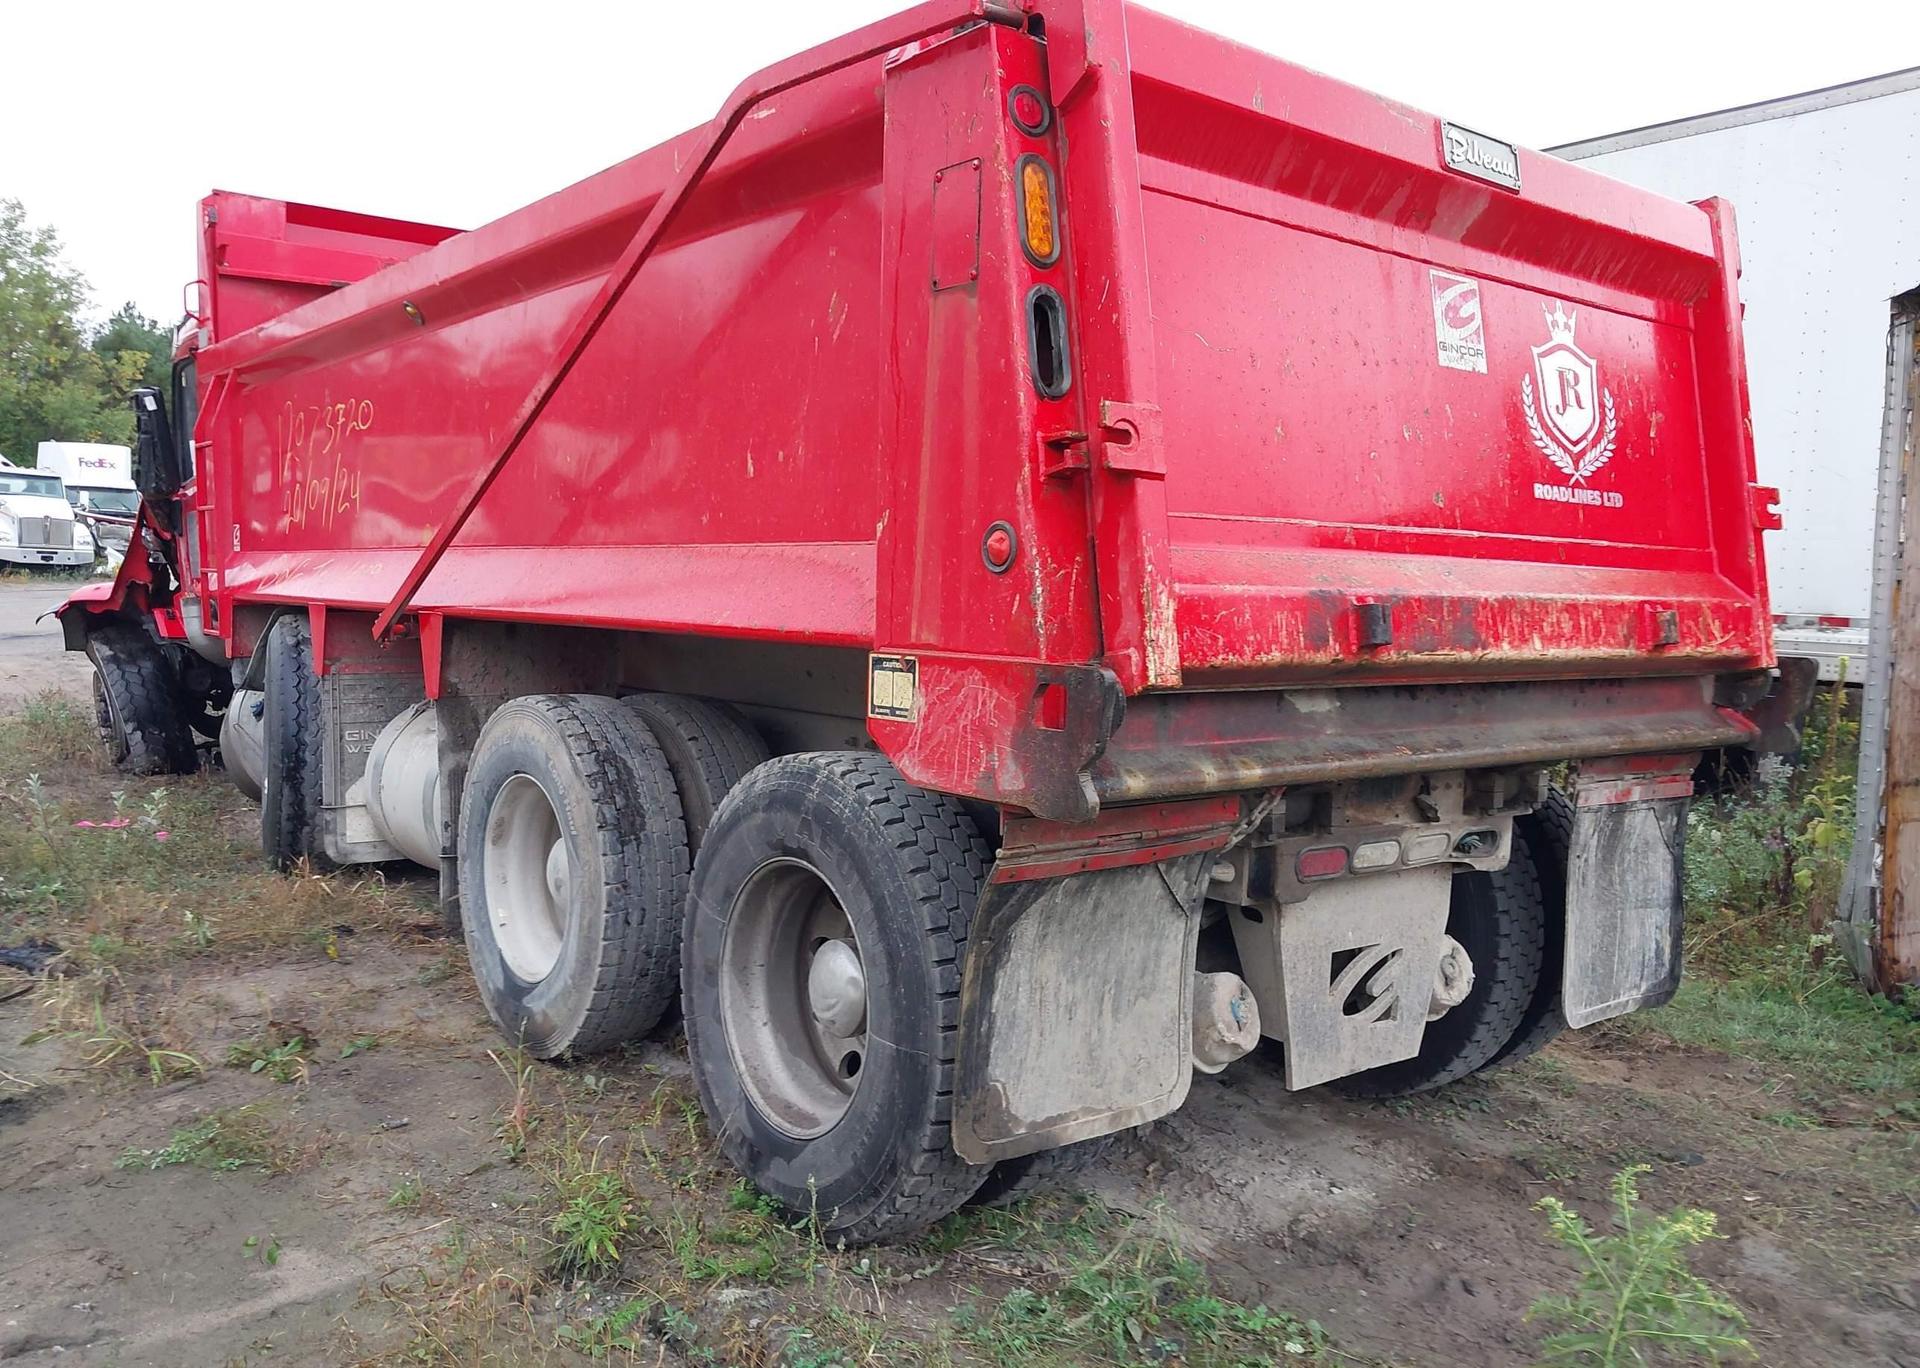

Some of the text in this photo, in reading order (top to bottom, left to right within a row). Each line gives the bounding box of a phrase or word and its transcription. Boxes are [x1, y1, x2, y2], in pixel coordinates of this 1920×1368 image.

[1438, 340, 1485, 359] GINCOR
[78, 457, 116, 469] FedEx
[1533, 482, 1624, 508] ROADLINES LTD
